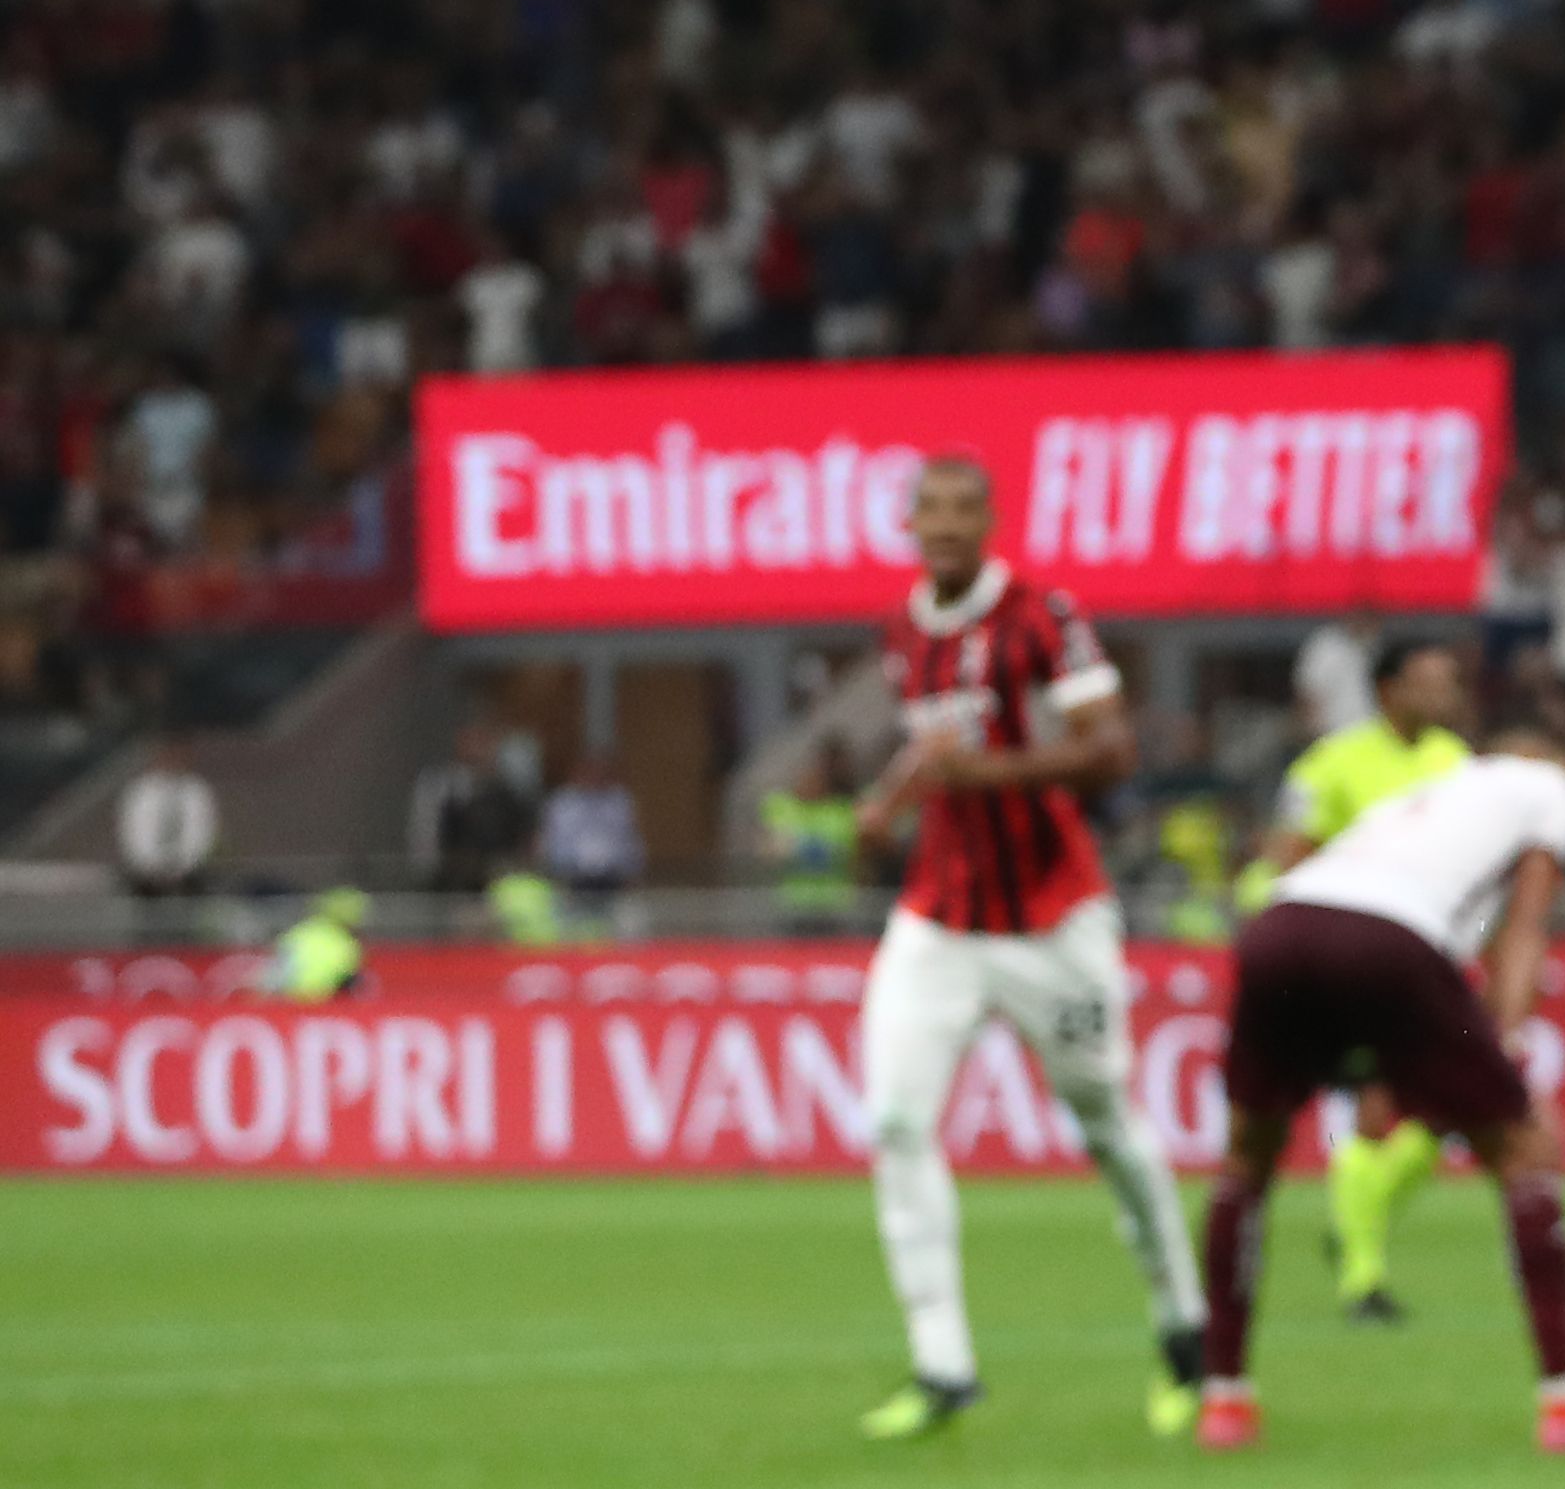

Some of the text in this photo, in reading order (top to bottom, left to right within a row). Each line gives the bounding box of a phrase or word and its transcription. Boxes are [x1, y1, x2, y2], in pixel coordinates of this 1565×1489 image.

[452, 405, 1480, 578] Emirate FLY BETTER
[38, 1015, 496, 1164] SCOPRI
